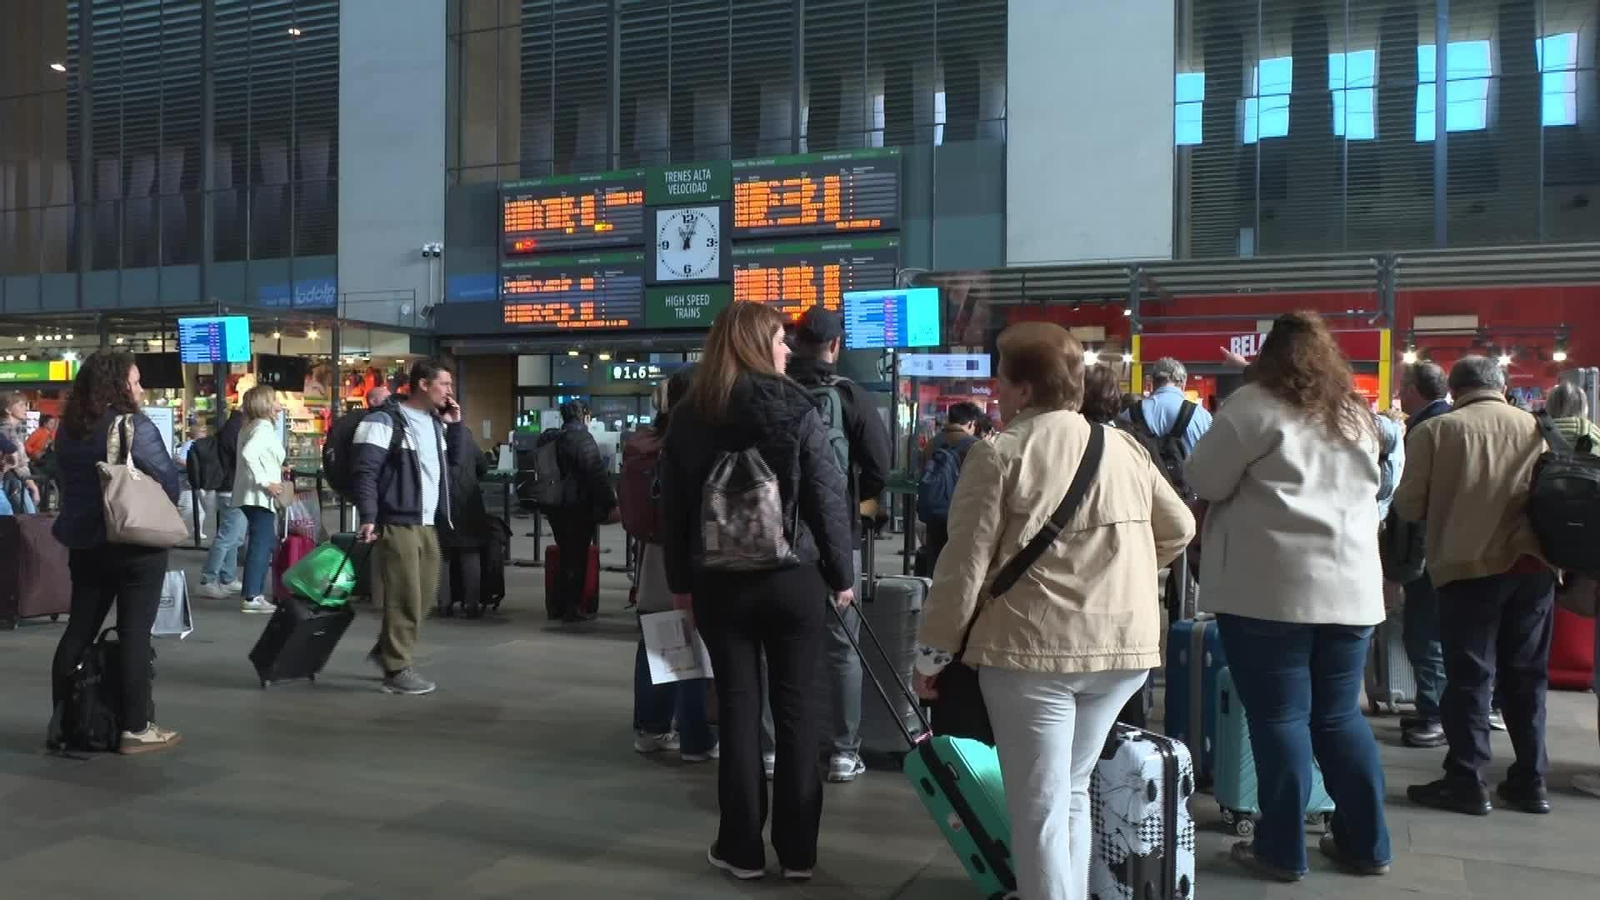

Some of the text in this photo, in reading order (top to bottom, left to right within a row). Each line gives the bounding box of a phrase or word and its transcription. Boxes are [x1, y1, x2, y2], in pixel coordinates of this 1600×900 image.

[665, 169, 711, 182] TRENES ALTA
[668, 182, 707, 195] VELOCIDAD
[682, 214, 695, 224] 12
[662, 241, 669, 250] 9
[706, 238, 714, 248] 3
[684, 265, 691, 274] 6
[666, 295, 710, 307] HIGH SPEED
[675, 308, 700, 319] TRAINS
